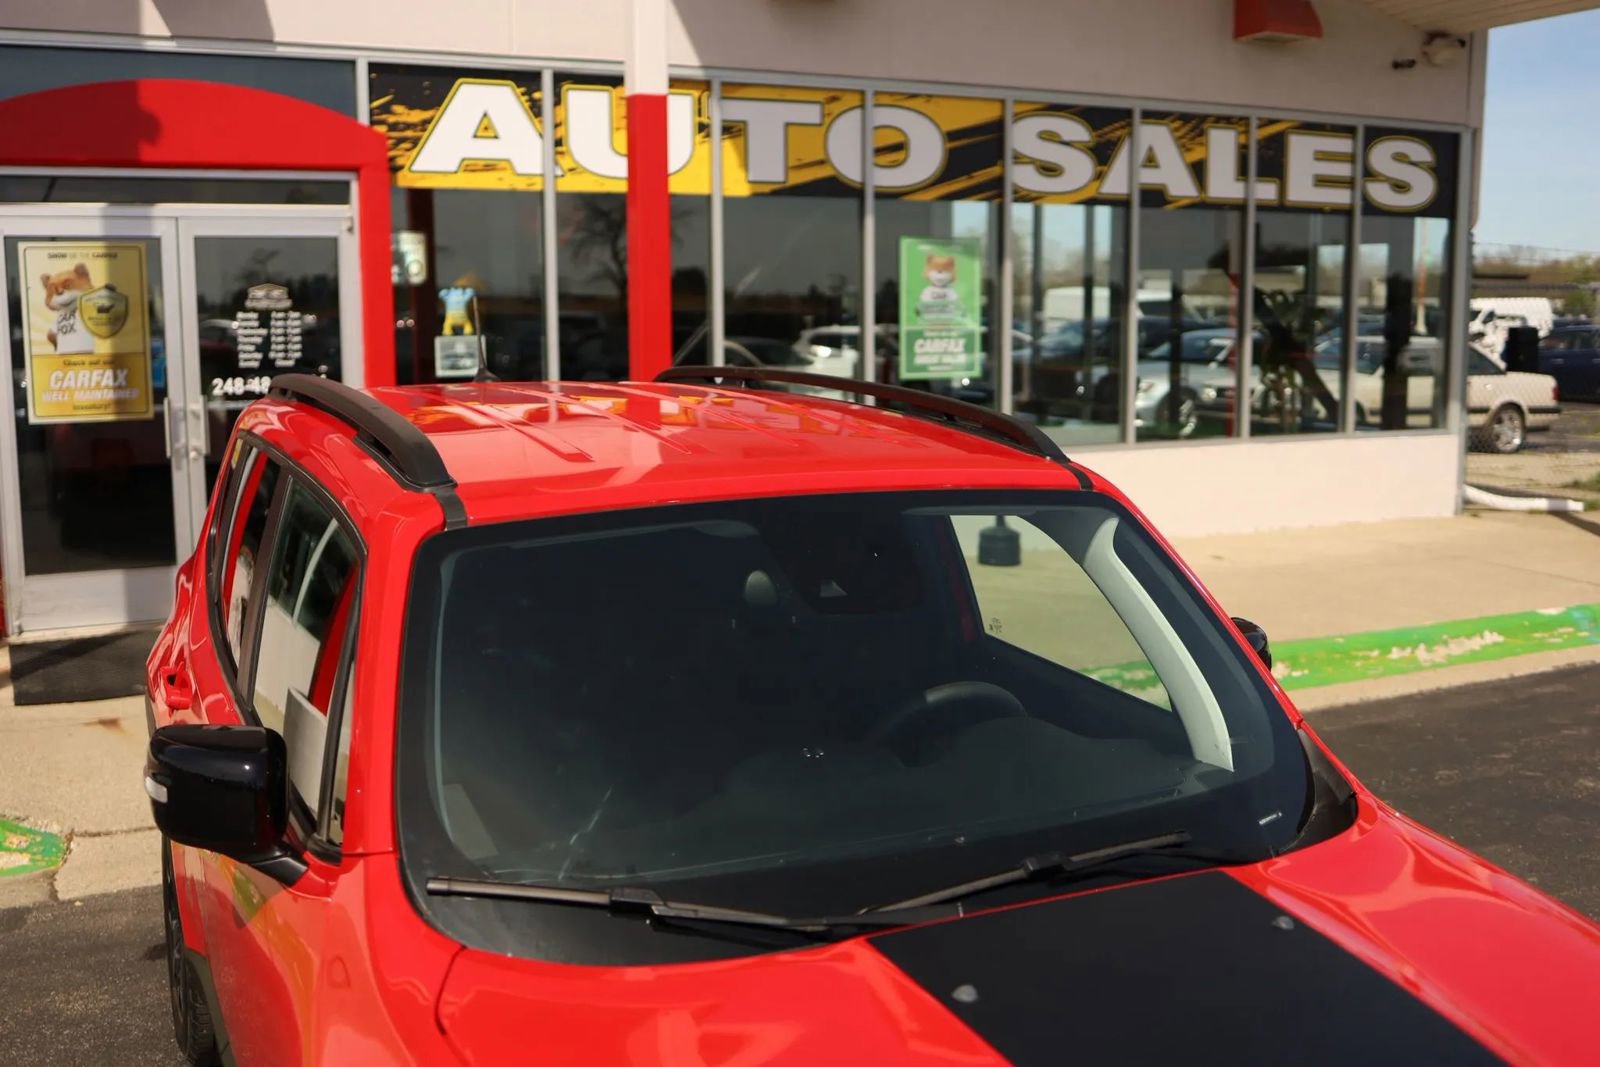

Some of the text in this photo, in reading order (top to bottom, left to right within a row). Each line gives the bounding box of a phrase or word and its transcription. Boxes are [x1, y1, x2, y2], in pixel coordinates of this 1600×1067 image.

[408, 78, 1437, 212] AUTO SALES
[50, 367, 129, 390] CARFAX
